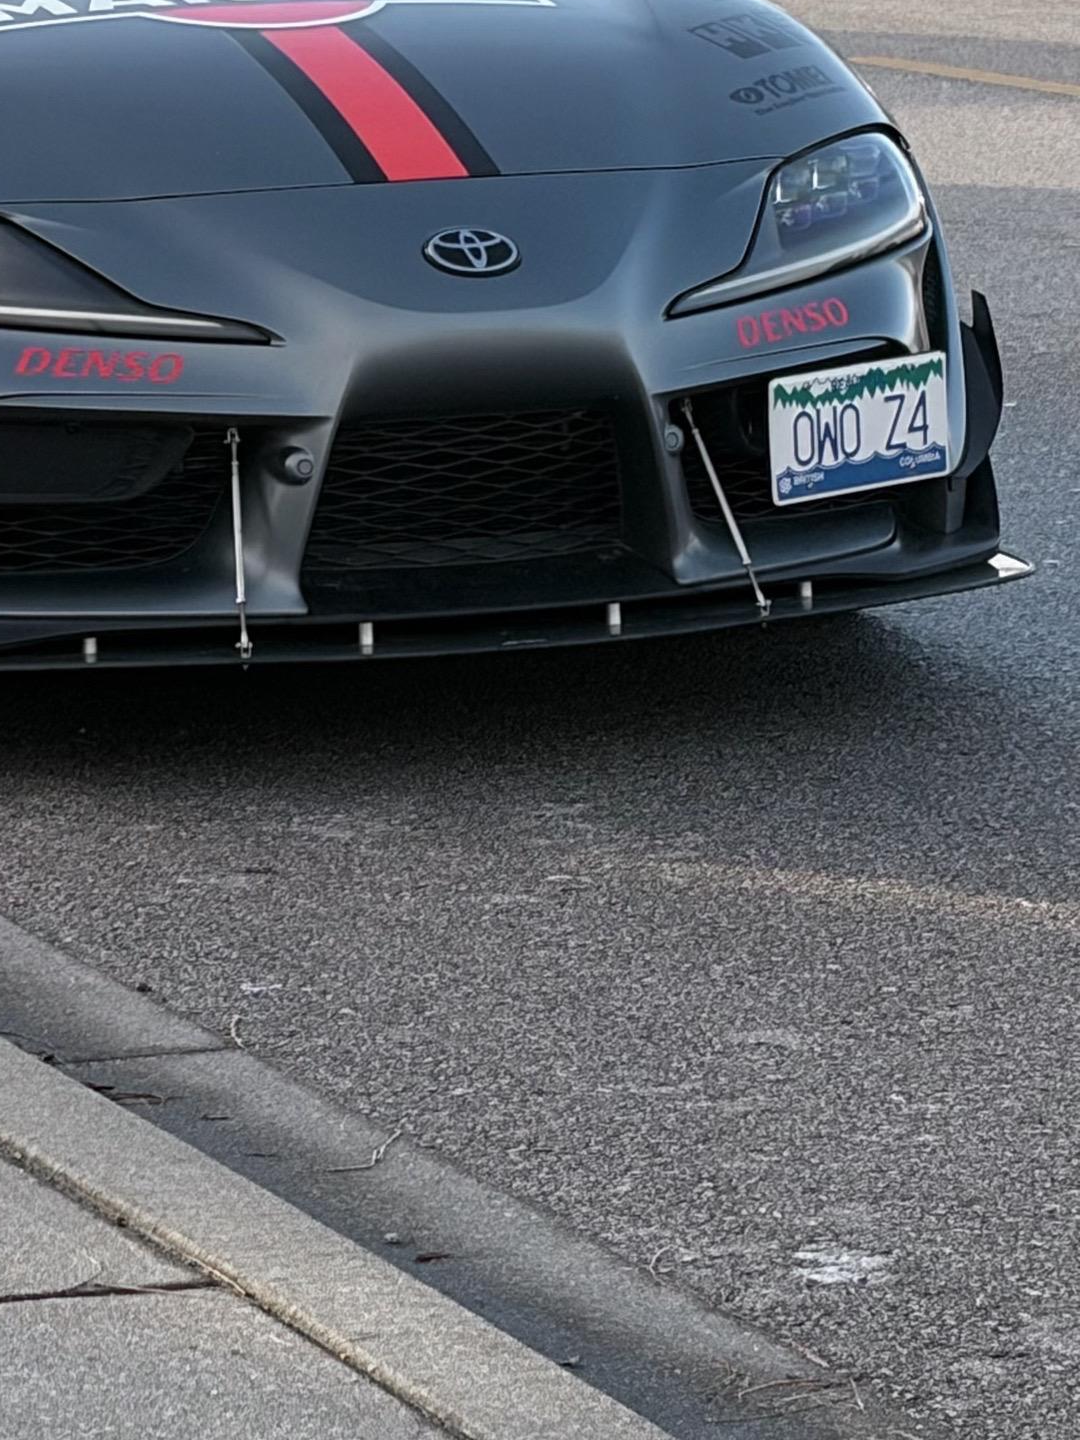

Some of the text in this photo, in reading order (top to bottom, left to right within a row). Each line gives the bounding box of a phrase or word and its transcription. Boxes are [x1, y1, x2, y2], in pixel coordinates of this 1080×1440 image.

[737, 297, 850, 349] DENSO
[15, 346, 184, 384] DENSO
[884, 389, 930, 451] Z4
